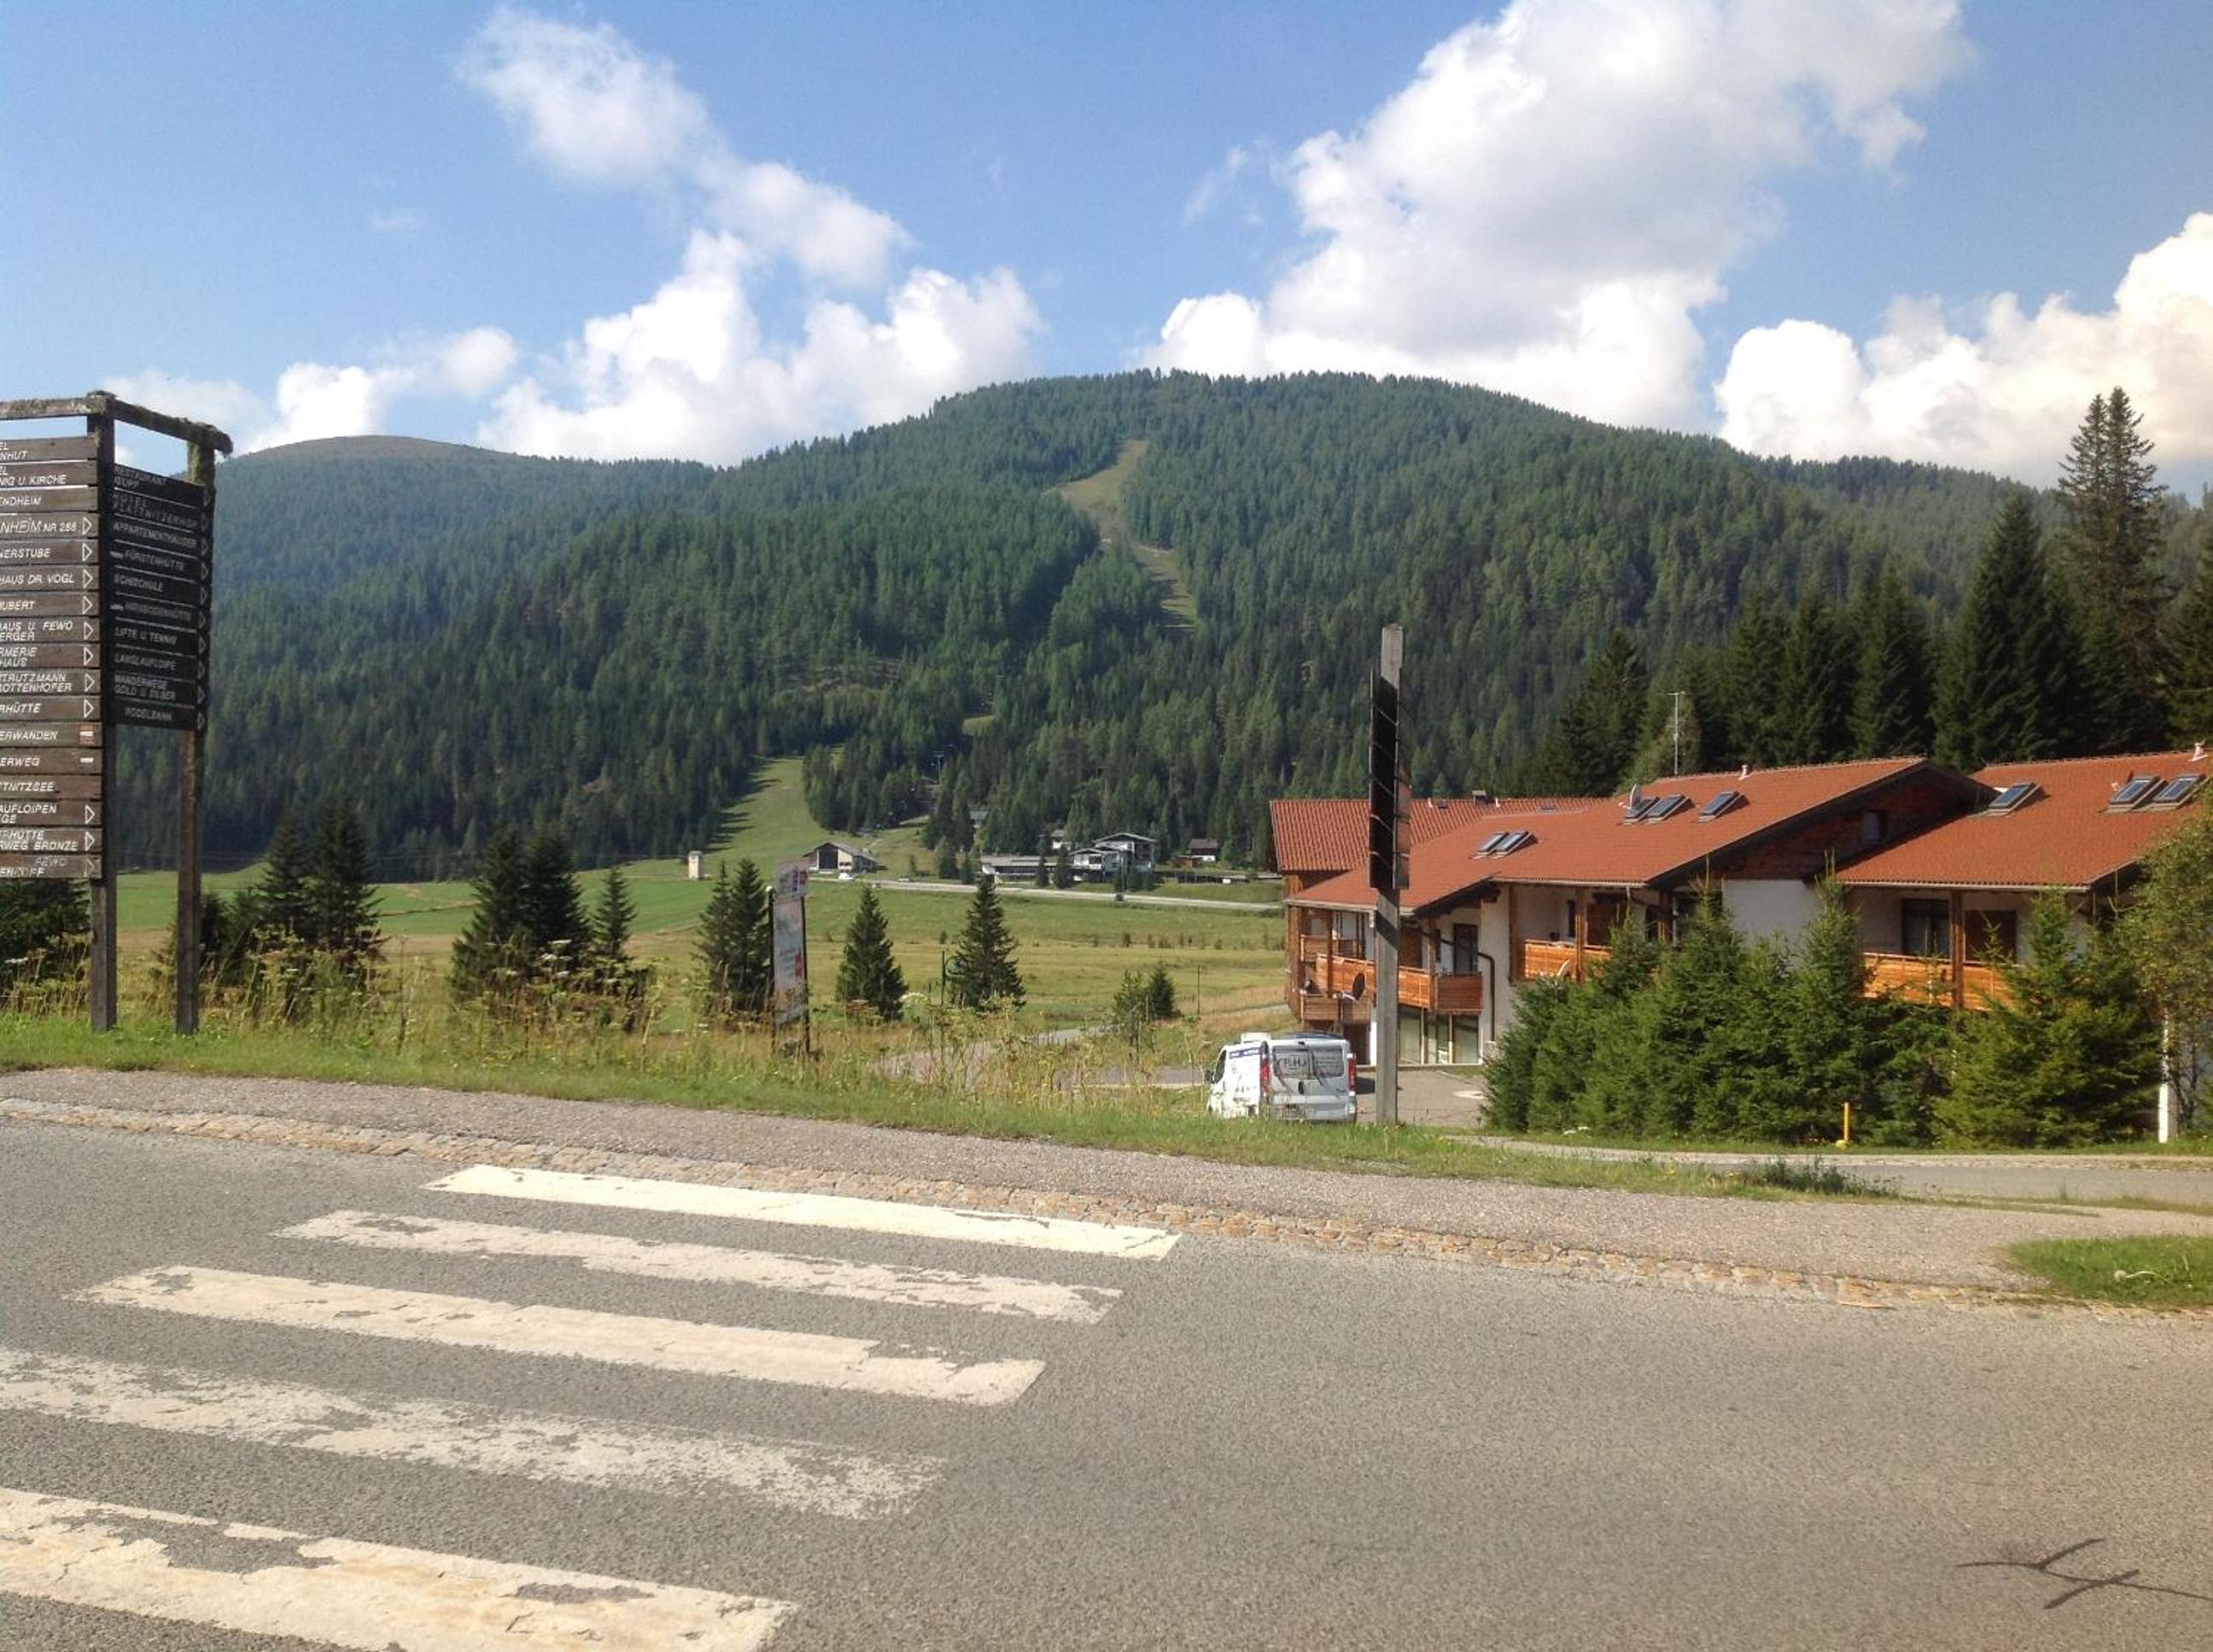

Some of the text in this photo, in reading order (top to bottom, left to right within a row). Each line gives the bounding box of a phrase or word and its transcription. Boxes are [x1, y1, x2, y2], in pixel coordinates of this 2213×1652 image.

[18, 476, 26, 486] U
[29, 474, 67, 485] KIRCHE
[0, 621, 22, 632] AUS
[42, 620, 73, 631] FEWO
[0, 814, 17, 824] GE
[33, 840, 79, 852] BRONZE
